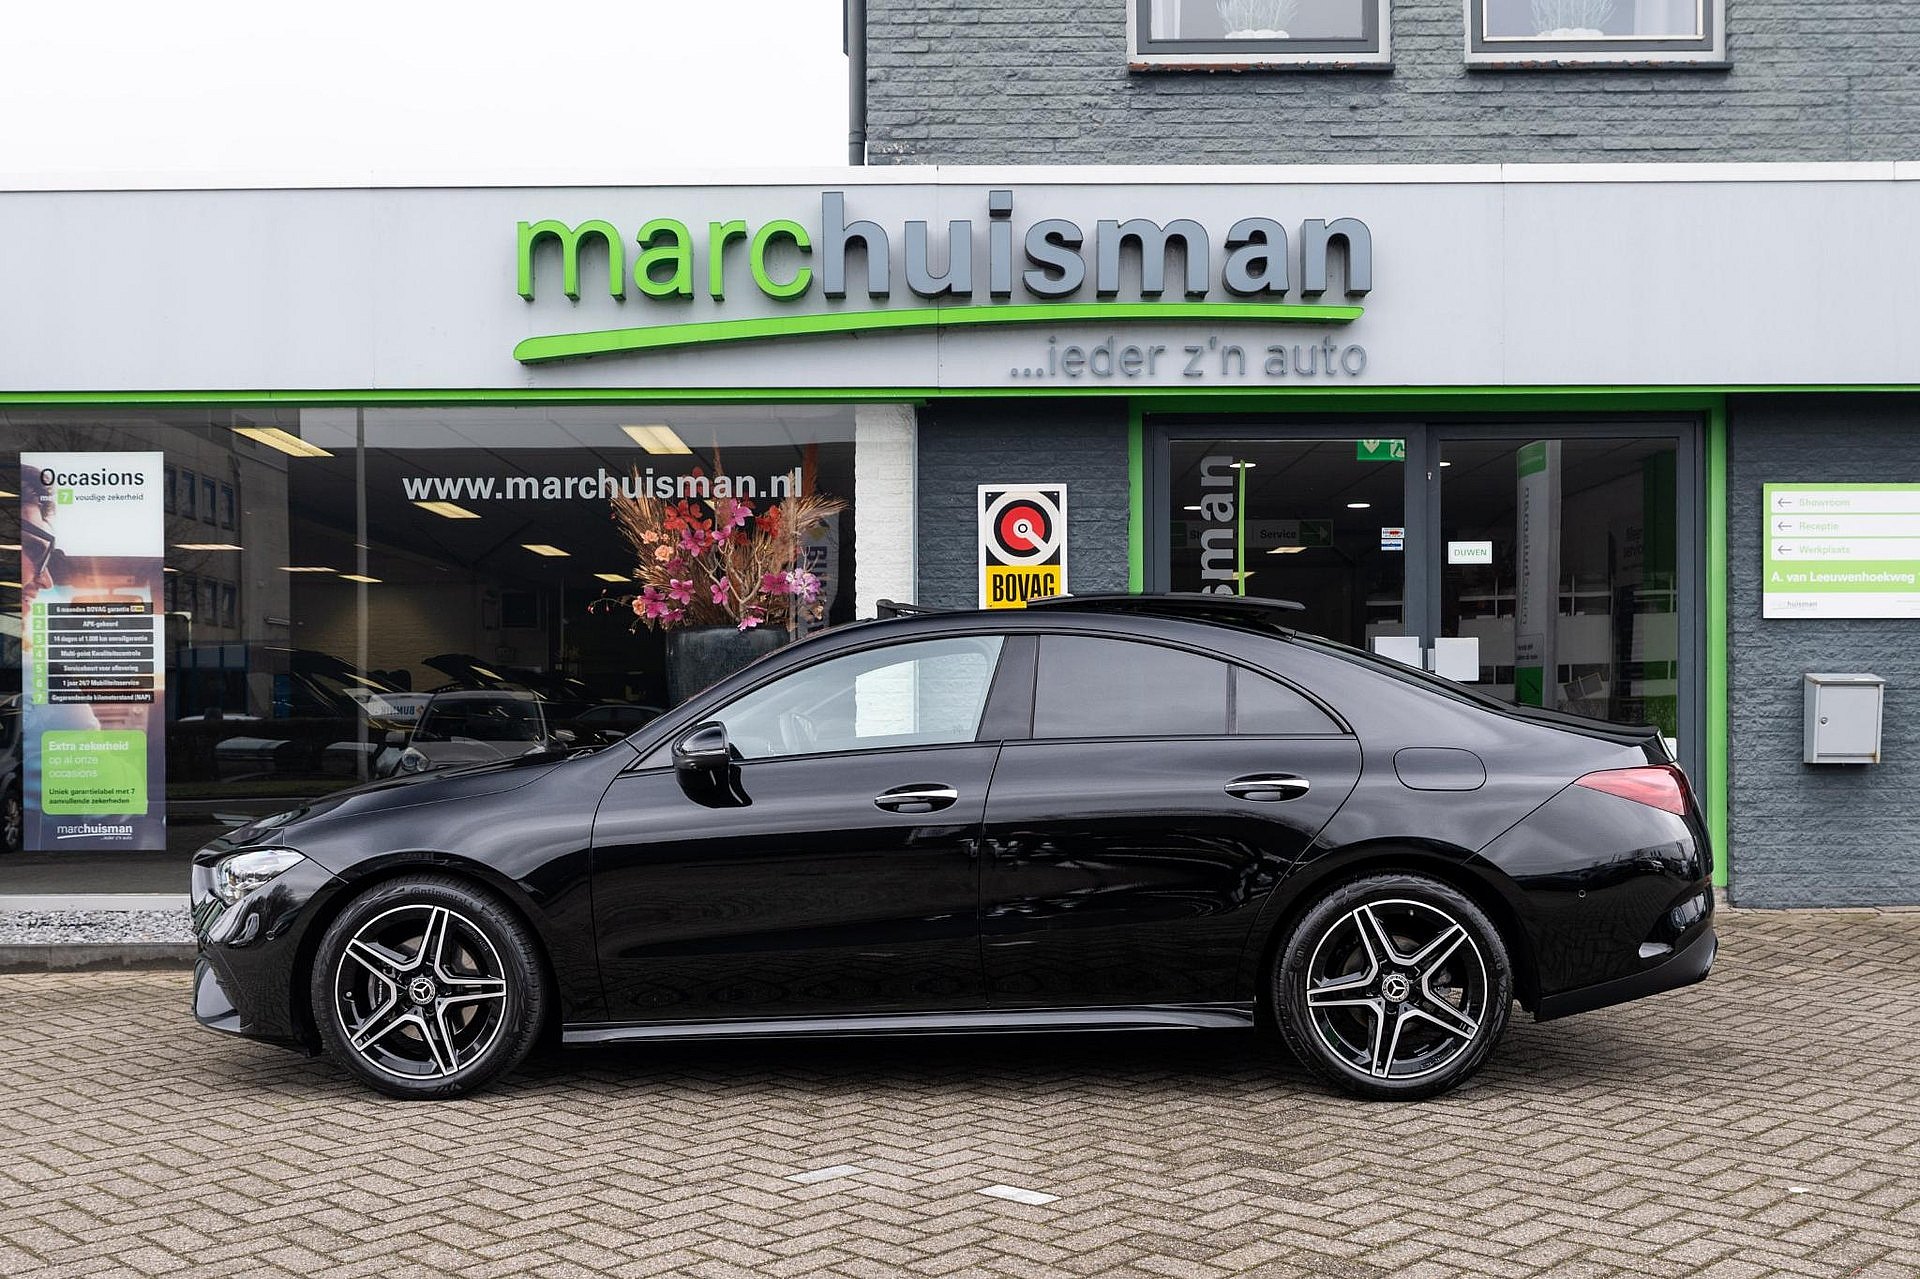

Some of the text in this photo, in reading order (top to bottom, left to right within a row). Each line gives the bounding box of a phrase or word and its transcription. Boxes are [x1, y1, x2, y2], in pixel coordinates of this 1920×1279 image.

[517, 191, 1373, 301] marchuisman
[1010, 335, 1367, 378] ...ieder z'n auto
[40, 468, 144, 486] Occasions
[402, 467, 803, 500] www.marchuisman.nl
[75, 493, 105, 502] voudige
[107, 493, 144, 501] zekerheid
[1799, 498, 1851, 507] Showroom
[1799, 521, 1840, 532] Receptie
[1259, 529, 1297, 540] Service
[1454, 548, 1488, 557] DUWEN
[1799, 545, 1851, 556] Werkplaats
[1771, 571, 1784, 583] A.
[1787, 572, 1807, 583] van
[1809, 571, 1916, 584] Leeuwenhoekweg
[992, 572, 1055, 602] BOVAG
[48, 741, 129, 751] Extra zekerheid
[48, 755, 98, 766] op al onze
[48, 769, 97, 778] occasions
[70, 788, 114, 796] garantielabel
[57, 823, 133, 834] marchuisman
